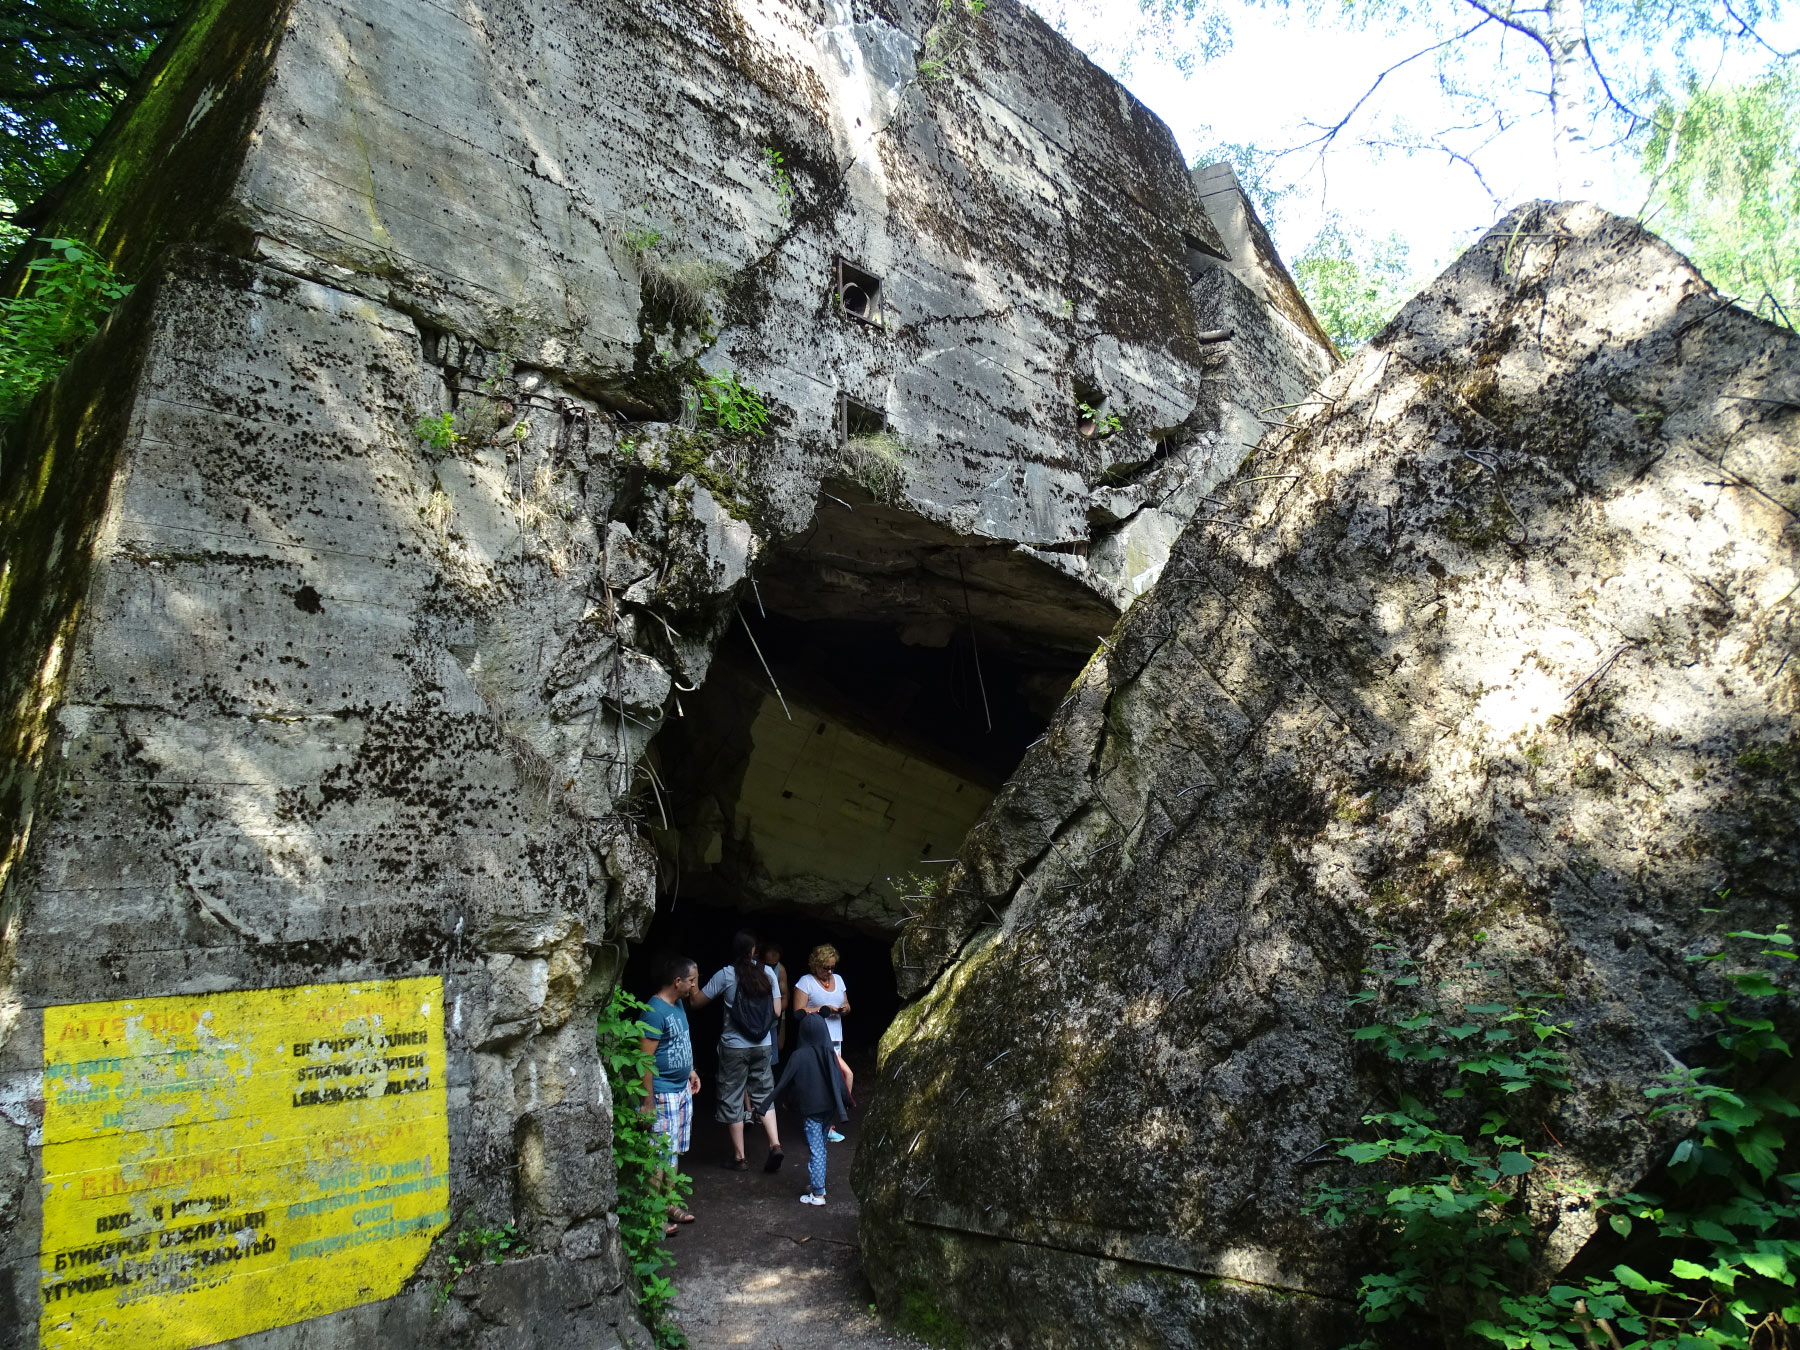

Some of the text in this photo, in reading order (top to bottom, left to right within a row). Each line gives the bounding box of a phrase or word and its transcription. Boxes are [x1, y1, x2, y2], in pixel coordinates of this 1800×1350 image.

[59, 1010, 202, 1041] ATTETIO
[45, 1062, 72, 1078] NO
[369, 1164, 388, 1183] DO
[96, 1212, 141, 1234] ВХО
